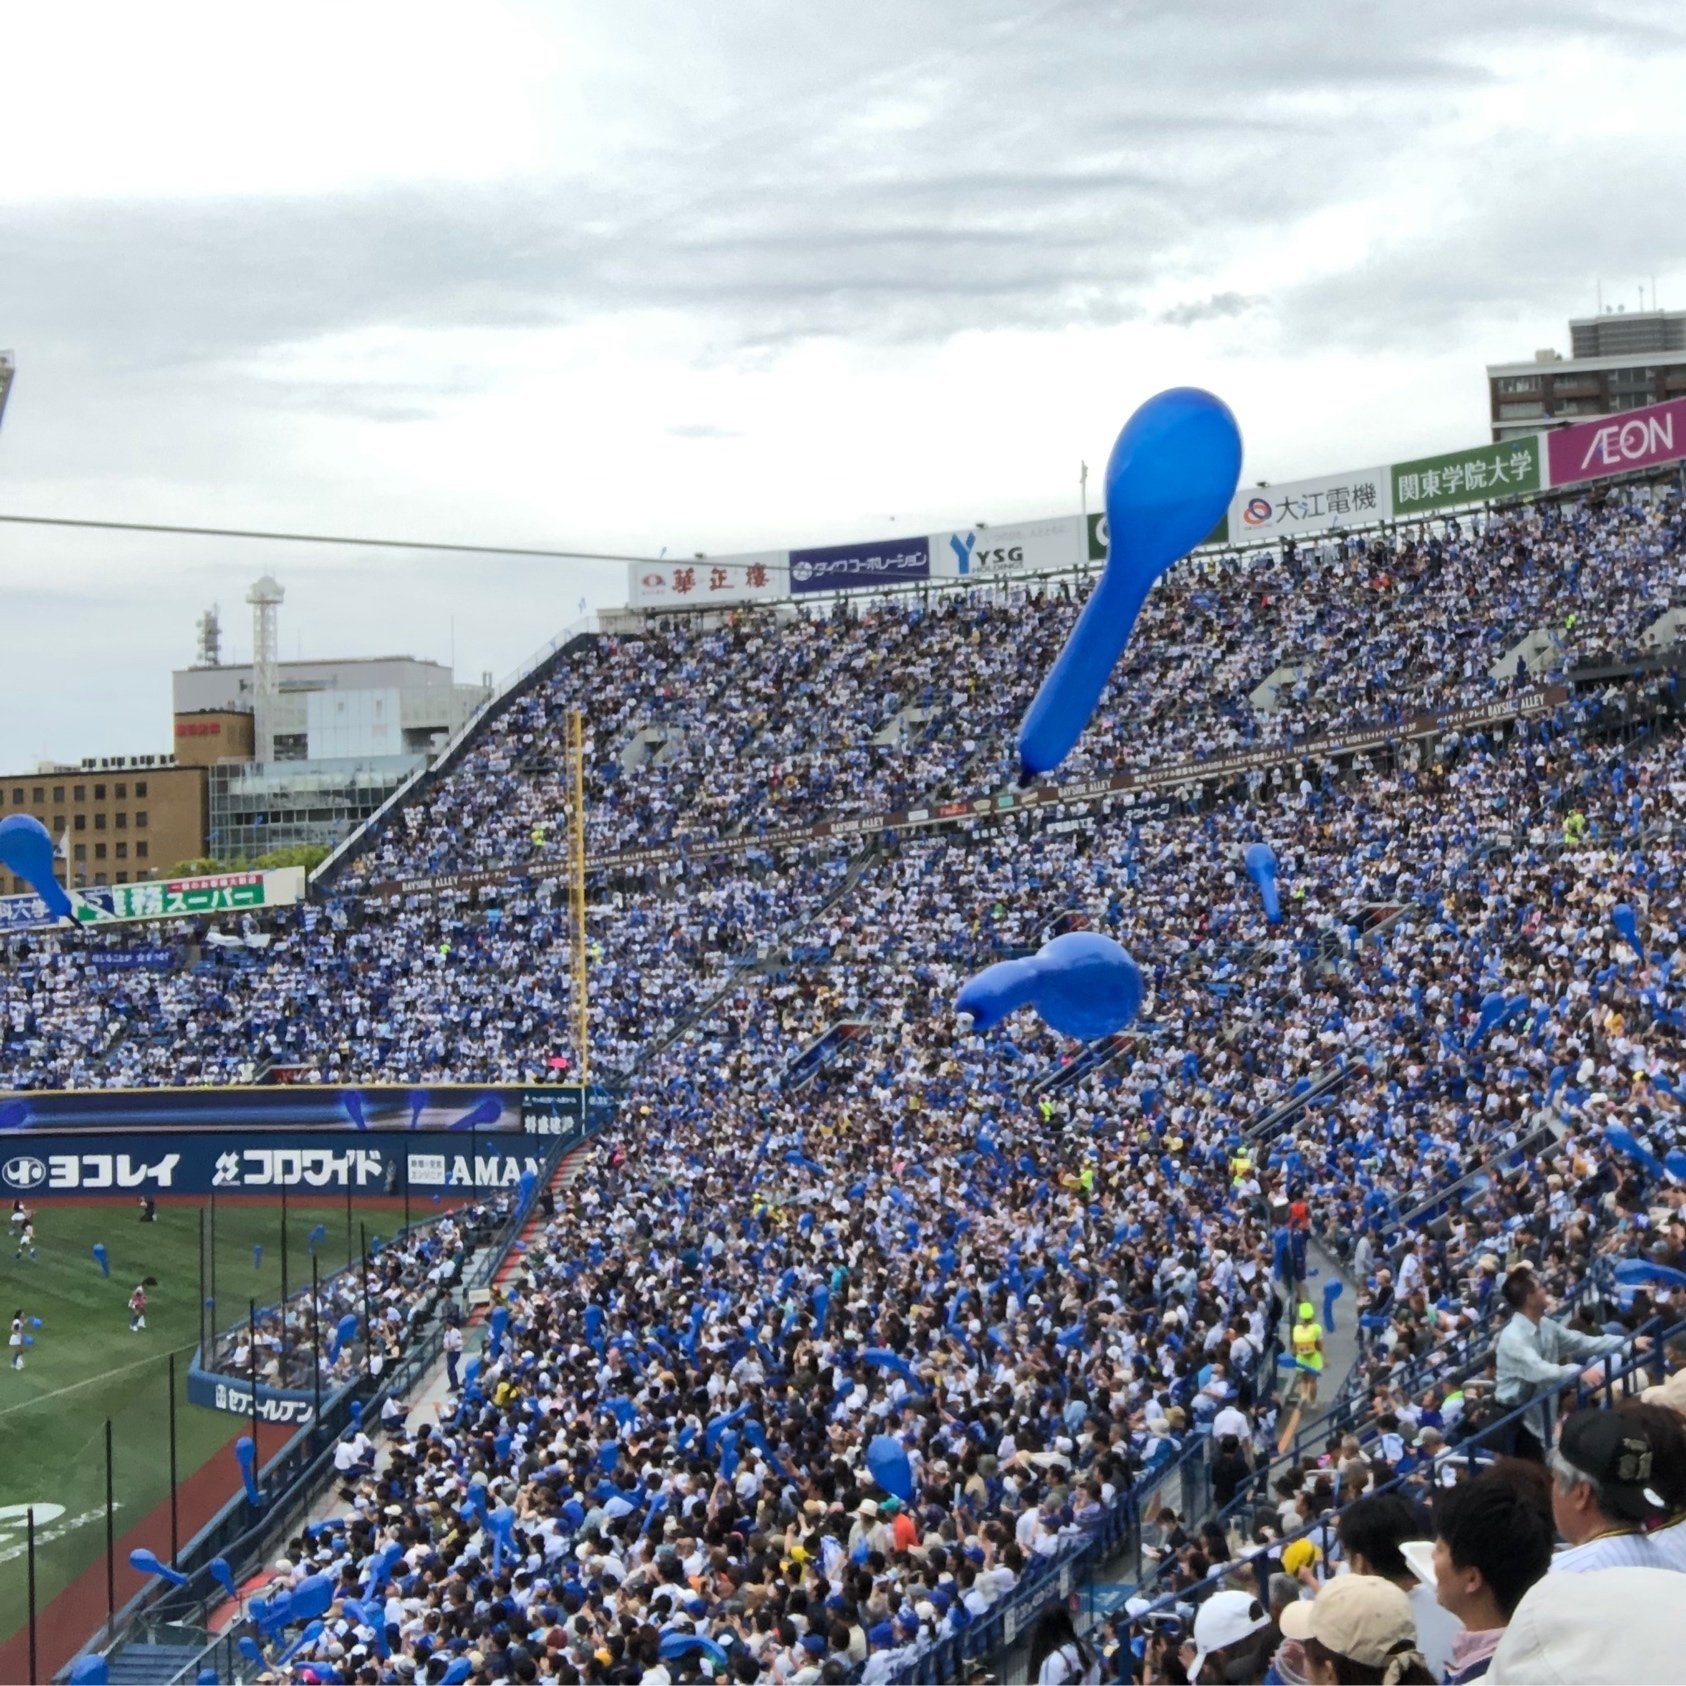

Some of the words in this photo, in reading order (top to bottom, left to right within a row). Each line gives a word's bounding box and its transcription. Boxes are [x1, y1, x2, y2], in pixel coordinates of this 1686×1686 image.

[1397, 450, 1533, 503] 関東学院大学
[1275, 482, 1377, 523] 大江電機
[813, 552, 928, 577] ダイワコーポレーション
[976, 546, 1024, 565] YSG
[972, 562, 1025, 574] HOLDINGS
[1520, 693, 1545, 709] ALLEY
[1088, 779, 1112, 793] ALLEY
[861, 815, 885, 829] ALLEY
[435, 875, 459, 888] ALLEY
[49, 1154, 180, 1187] ヨコレイ
[243, 1149, 383, 1186] コロワイド
